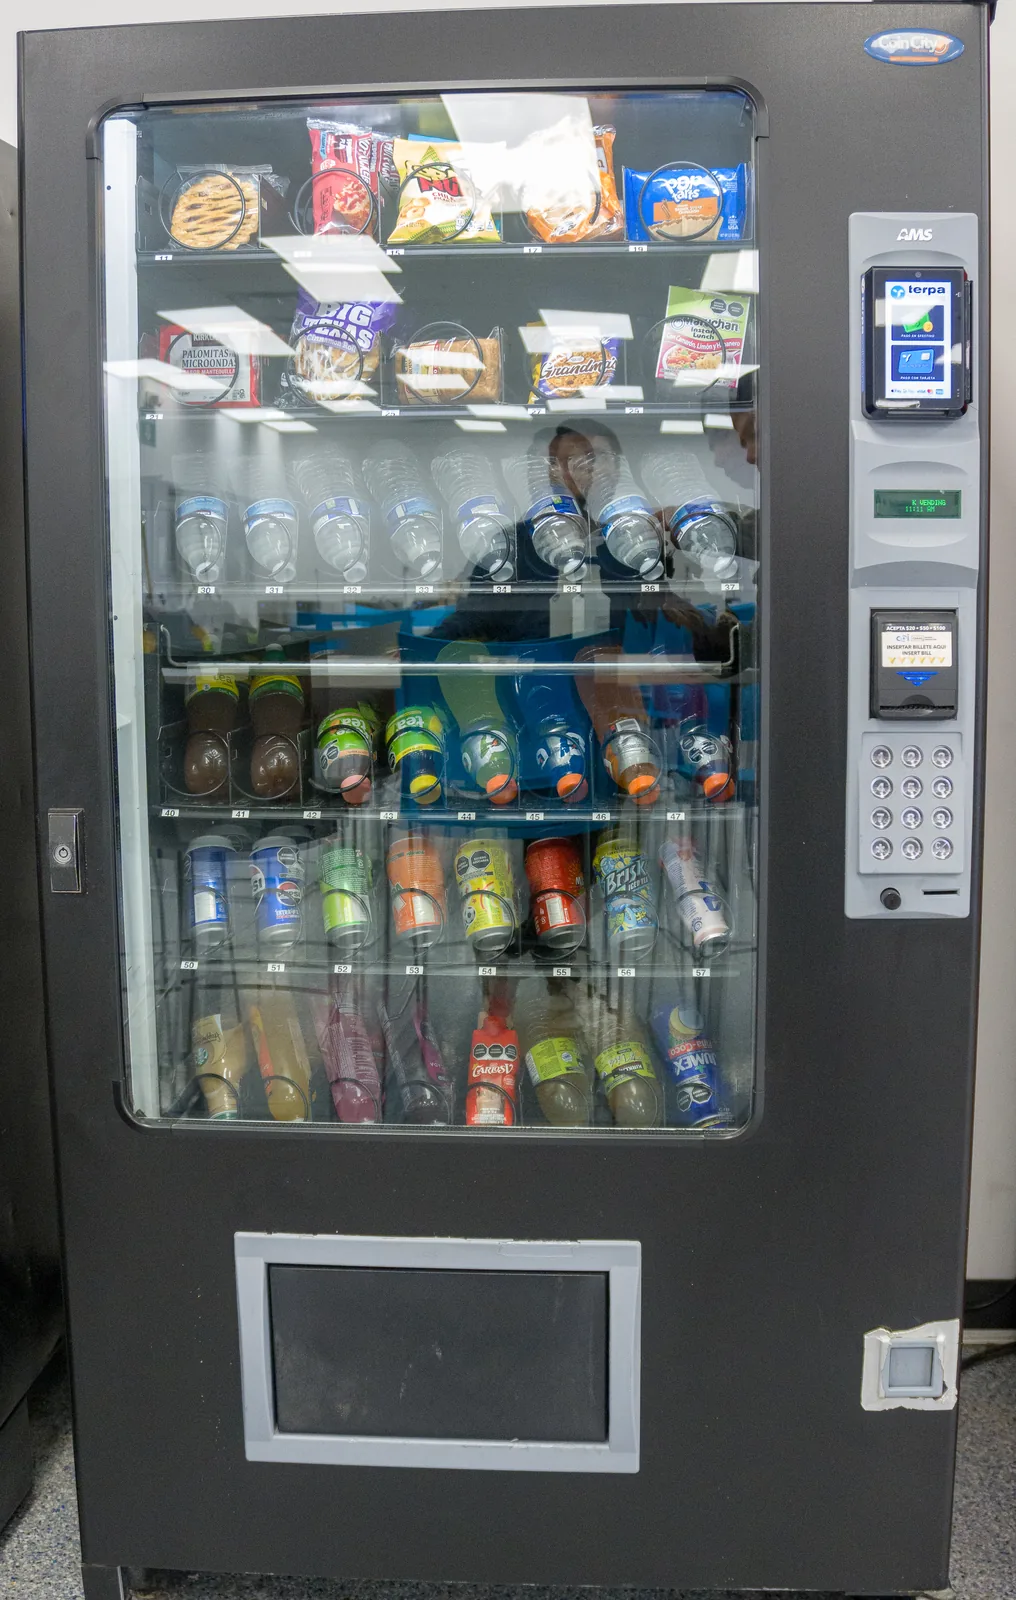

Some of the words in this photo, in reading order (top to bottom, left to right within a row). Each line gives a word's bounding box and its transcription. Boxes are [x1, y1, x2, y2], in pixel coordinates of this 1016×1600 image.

[879, 36, 910, 51] Coin
[910, 35, 937, 53] City
[896, 228, 932, 241] AMS
[908, 285, 946, 295] terpa
[316, 302, 373, 327] BIG
[302, 317, 375, 350] TEXAS
[690, 326, 716, 337] Instan
[692, 332, 715, 340] Lunch
[697, 341, 713, 350] Limón
[182, 349, 229, 359] PALOMITAS
[165, 809, 176, 817] 40
[235, 810, 246, 818] 41
[306, 811, 317, 819] 42
[673, 1052, 717, 1076] JUMEX
[472, 1064, 506, 1077] CARLOS
[505, 1063, 514, 1074] V
